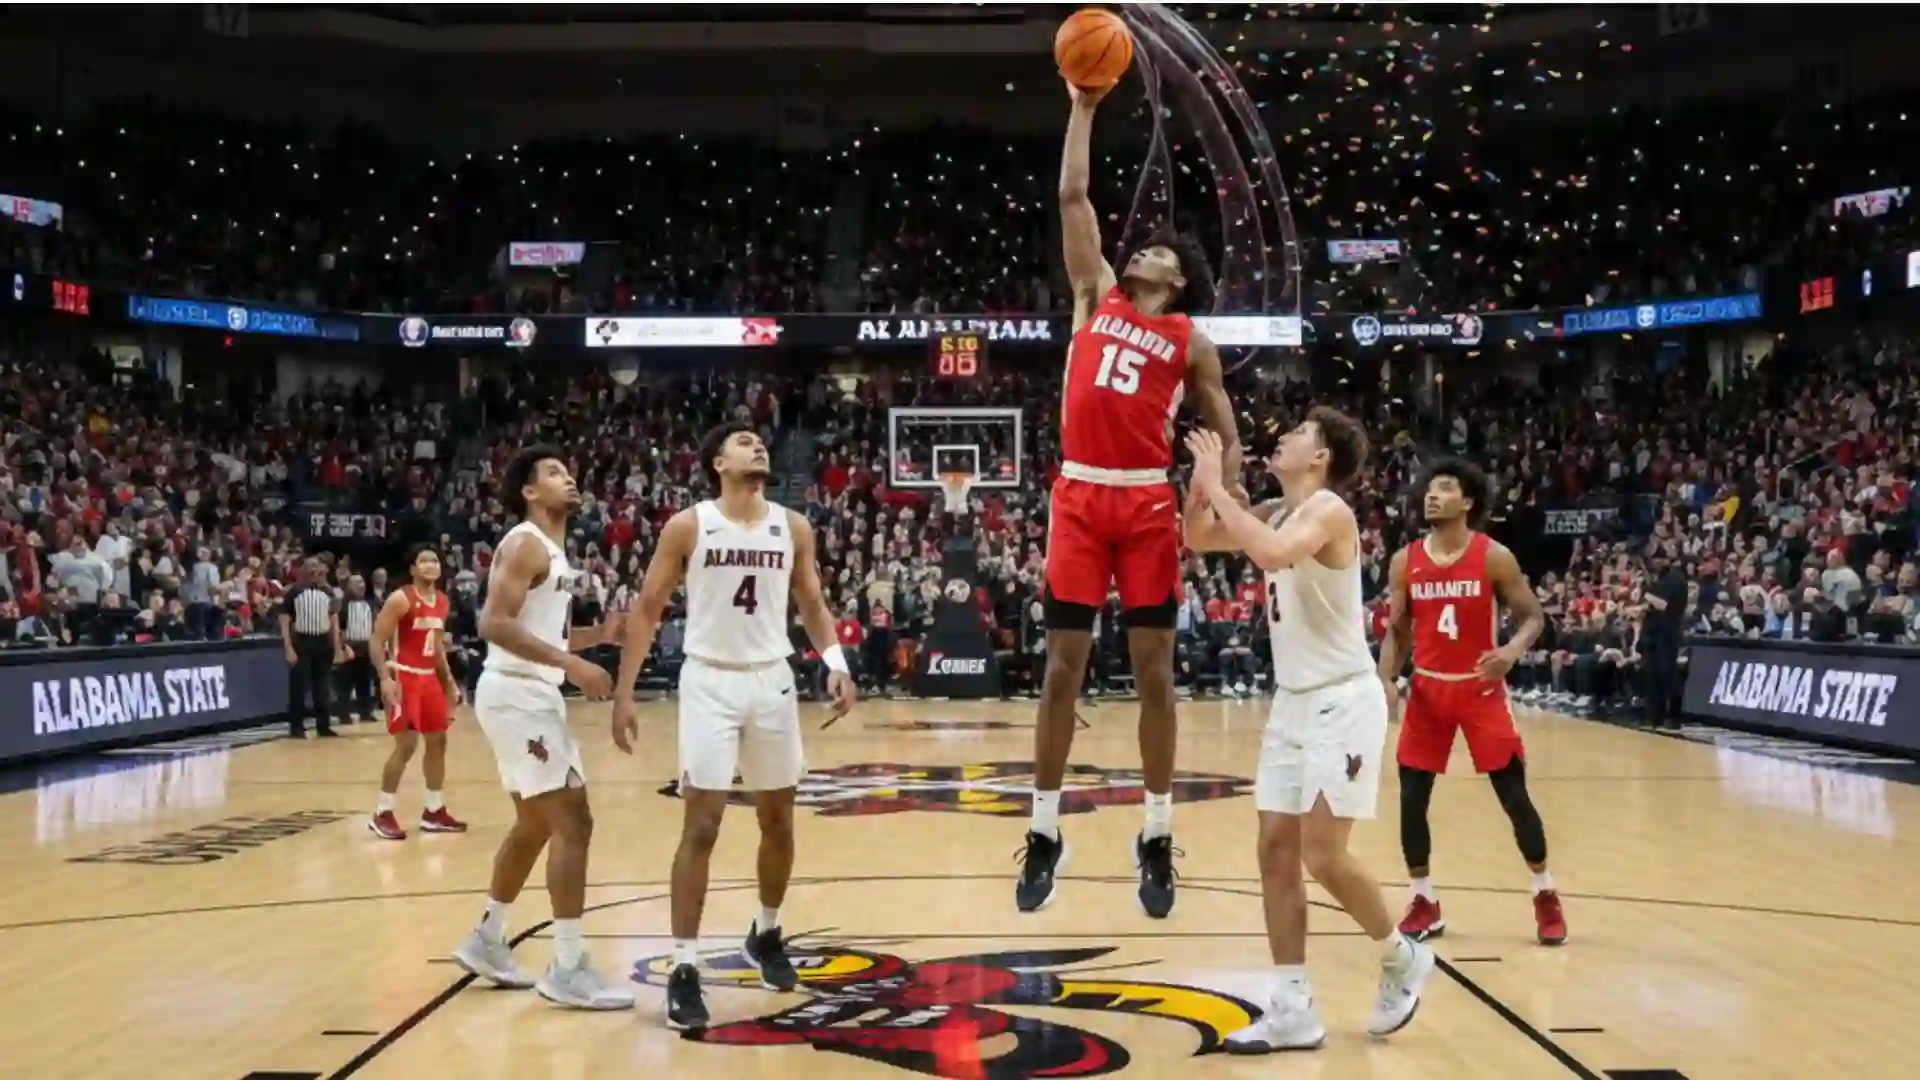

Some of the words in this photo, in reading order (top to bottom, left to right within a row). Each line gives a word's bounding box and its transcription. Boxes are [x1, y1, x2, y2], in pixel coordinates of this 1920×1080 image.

[1094, 343, 1148, 395] 15
[732, 574, 758, 615] 4
[1437, 603, 1458, 640] 4
[32, 671, 164, 735] ALABAMA
[164, 664, 230, 716] STATE
[1709, 660, 1813, 715] ALABAMA
[1813, 669, 1898, 727] STATE
